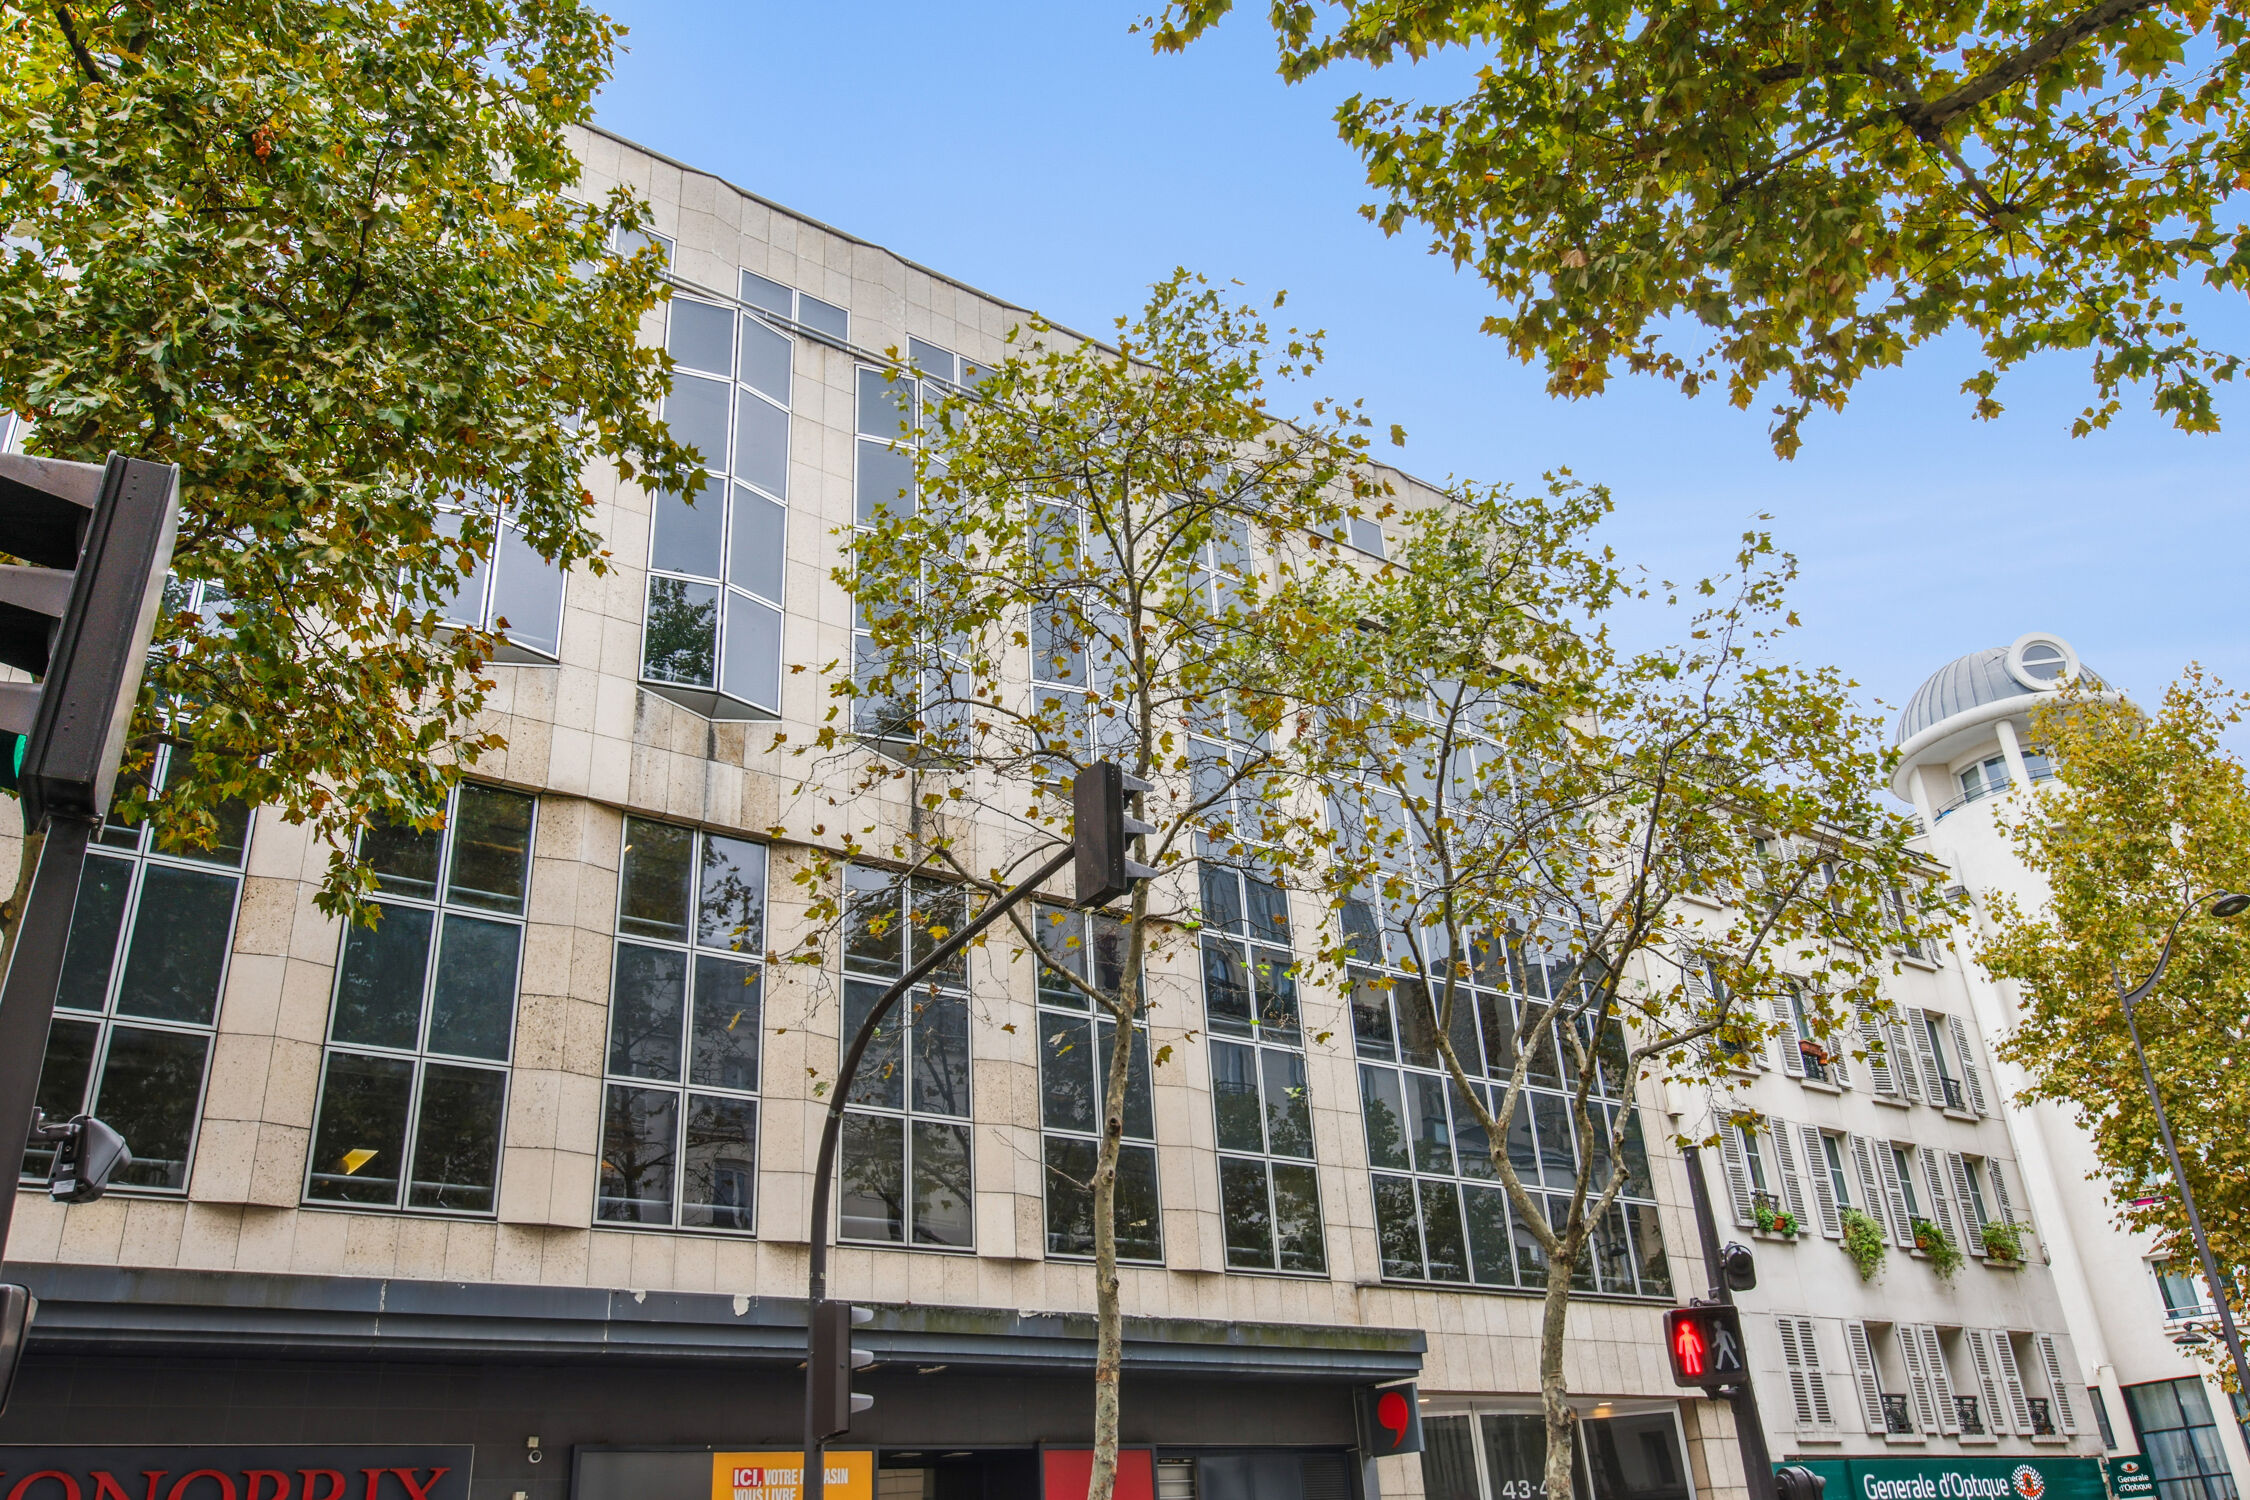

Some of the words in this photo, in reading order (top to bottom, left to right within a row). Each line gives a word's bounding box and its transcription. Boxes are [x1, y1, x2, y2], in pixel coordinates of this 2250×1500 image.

[733, 1468, 762, 1487] ICI,
[763, 1468, 798, 1486] VOTRE
[2117, 1473, 2150, 1484] Generale
[1863, 1472, 1937, 1500] Generale
[1938, 1472, 2010, 1500] d'Optique
[2118, 1483, 2153, 1493] d'Optique
[733, 1488, 764, 1500] VOUS
[765, 1487, 797, 1500] LIVRE
